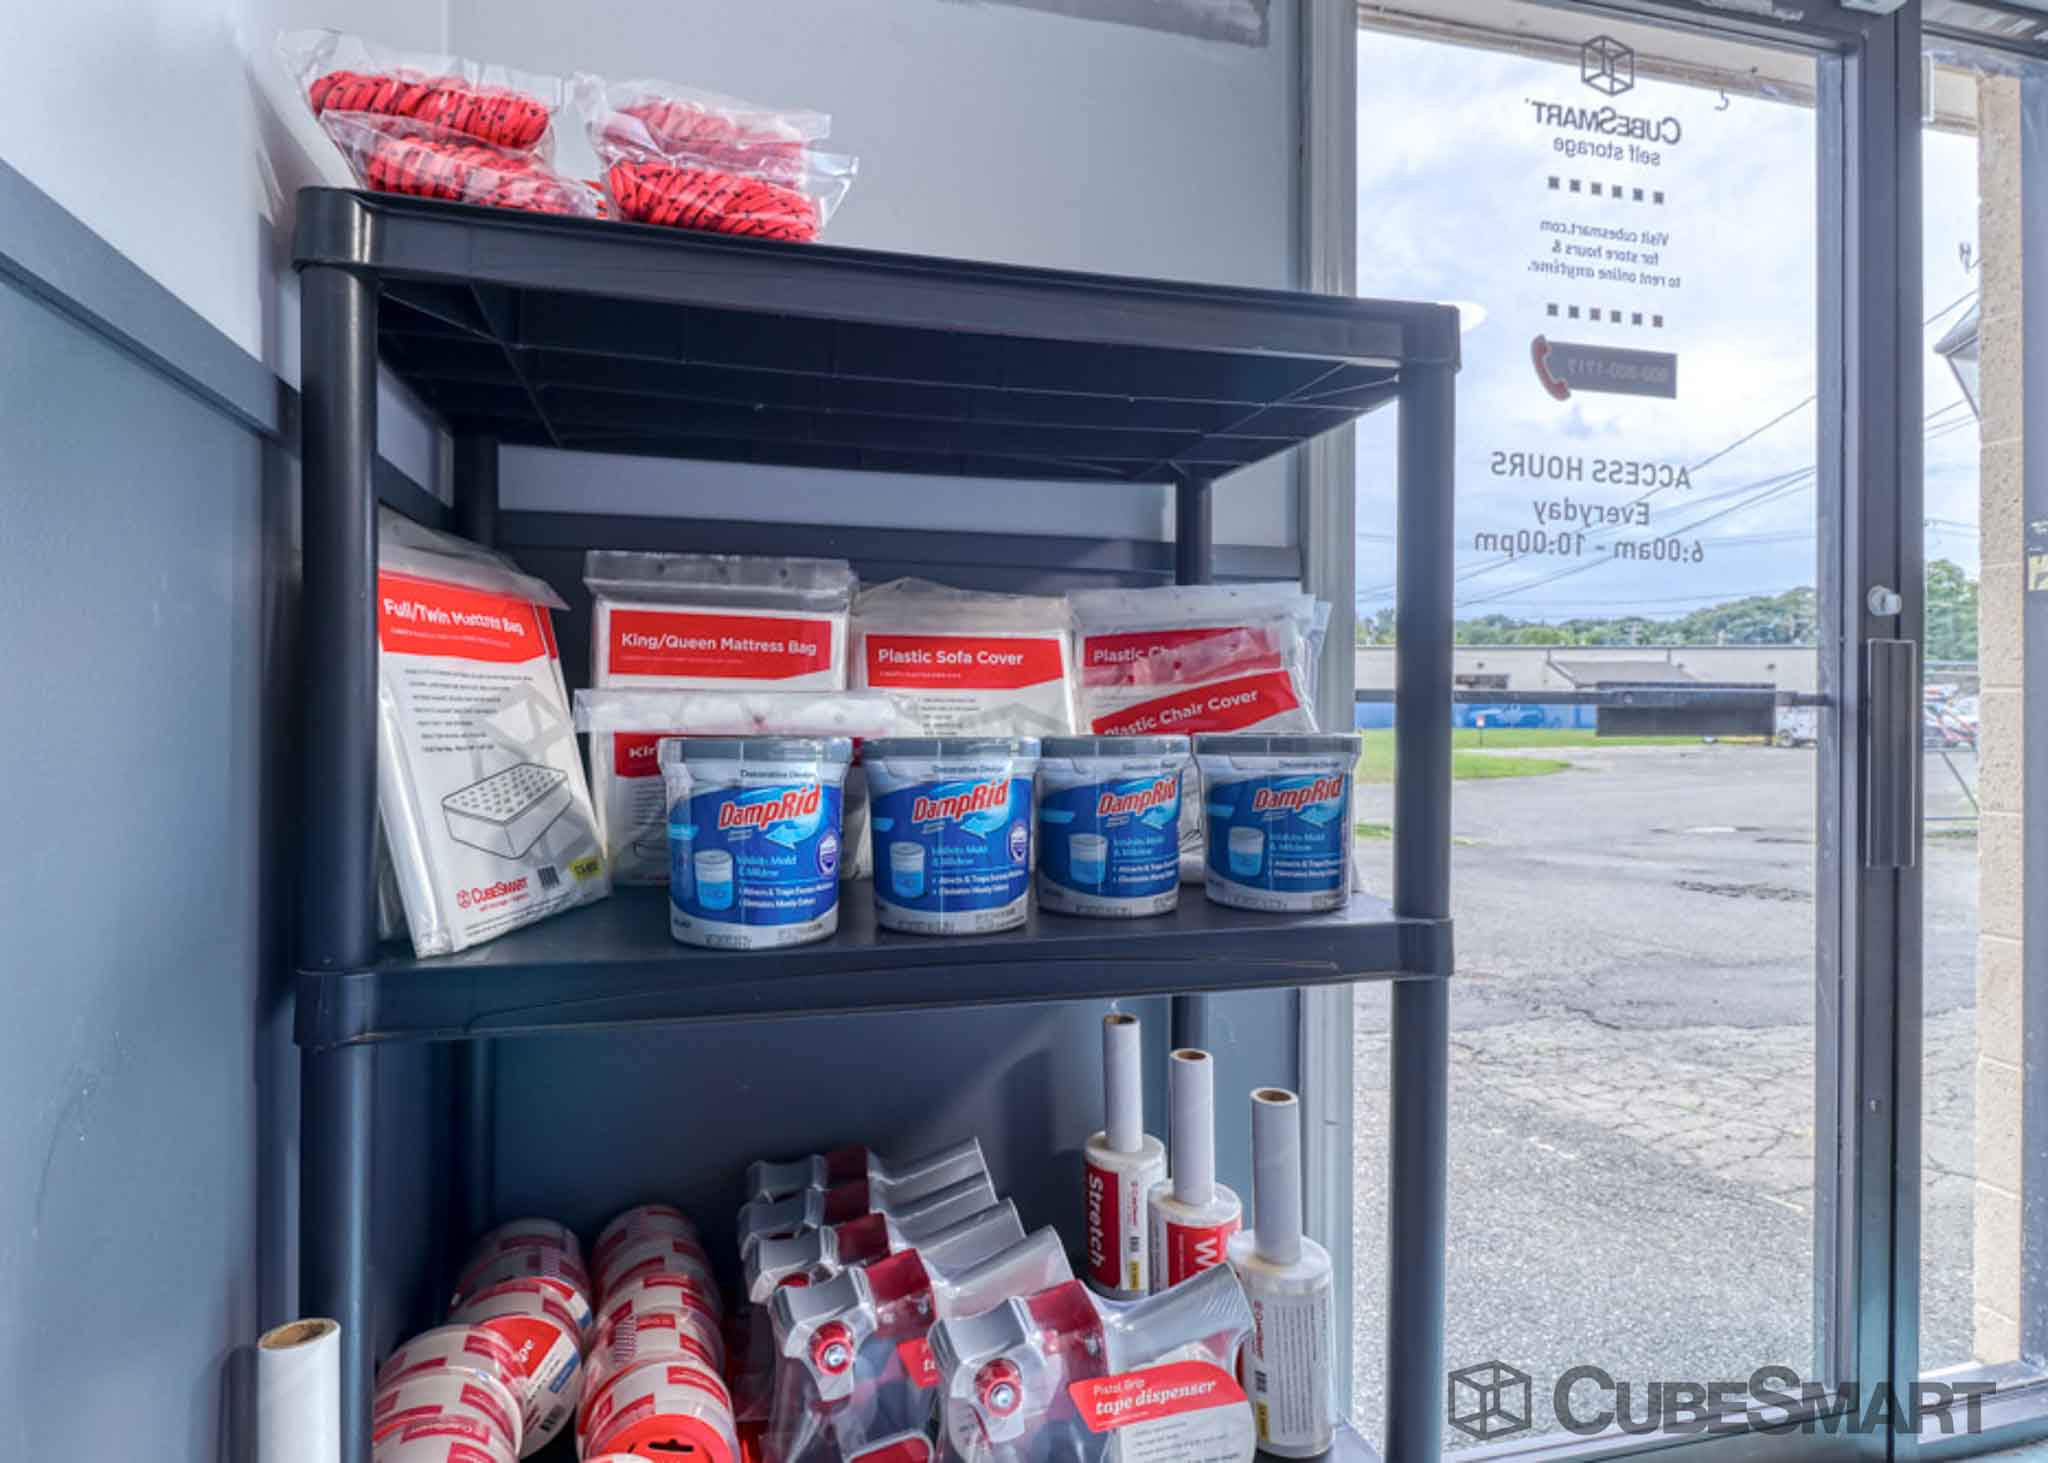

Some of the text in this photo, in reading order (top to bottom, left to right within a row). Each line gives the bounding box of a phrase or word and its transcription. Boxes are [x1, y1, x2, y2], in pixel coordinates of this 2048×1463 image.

[383, 597, 526, 636] Full/Twin Mattress Bag
[620, 631, 817, 657] King/Queen Mattress Bag
[877, 647, 1025, 666] Plastic Sofa Cover
[1092, 646, 1145, 663] Plastic
[1159, 702, 1204, 726] Chair
[1207, 688, 1260, 712] Cover
[717, 783, 822, 831] DampRid
[911, 776, 1011, 824] DampRid
[1096, 774, 1178, 816] DampRid
[1252, 771, 1345, 812] DampRid
[1088, 1172, 1105, 1267] Stretch
[1095, 1380, 1216, 1416] tape dispenser
